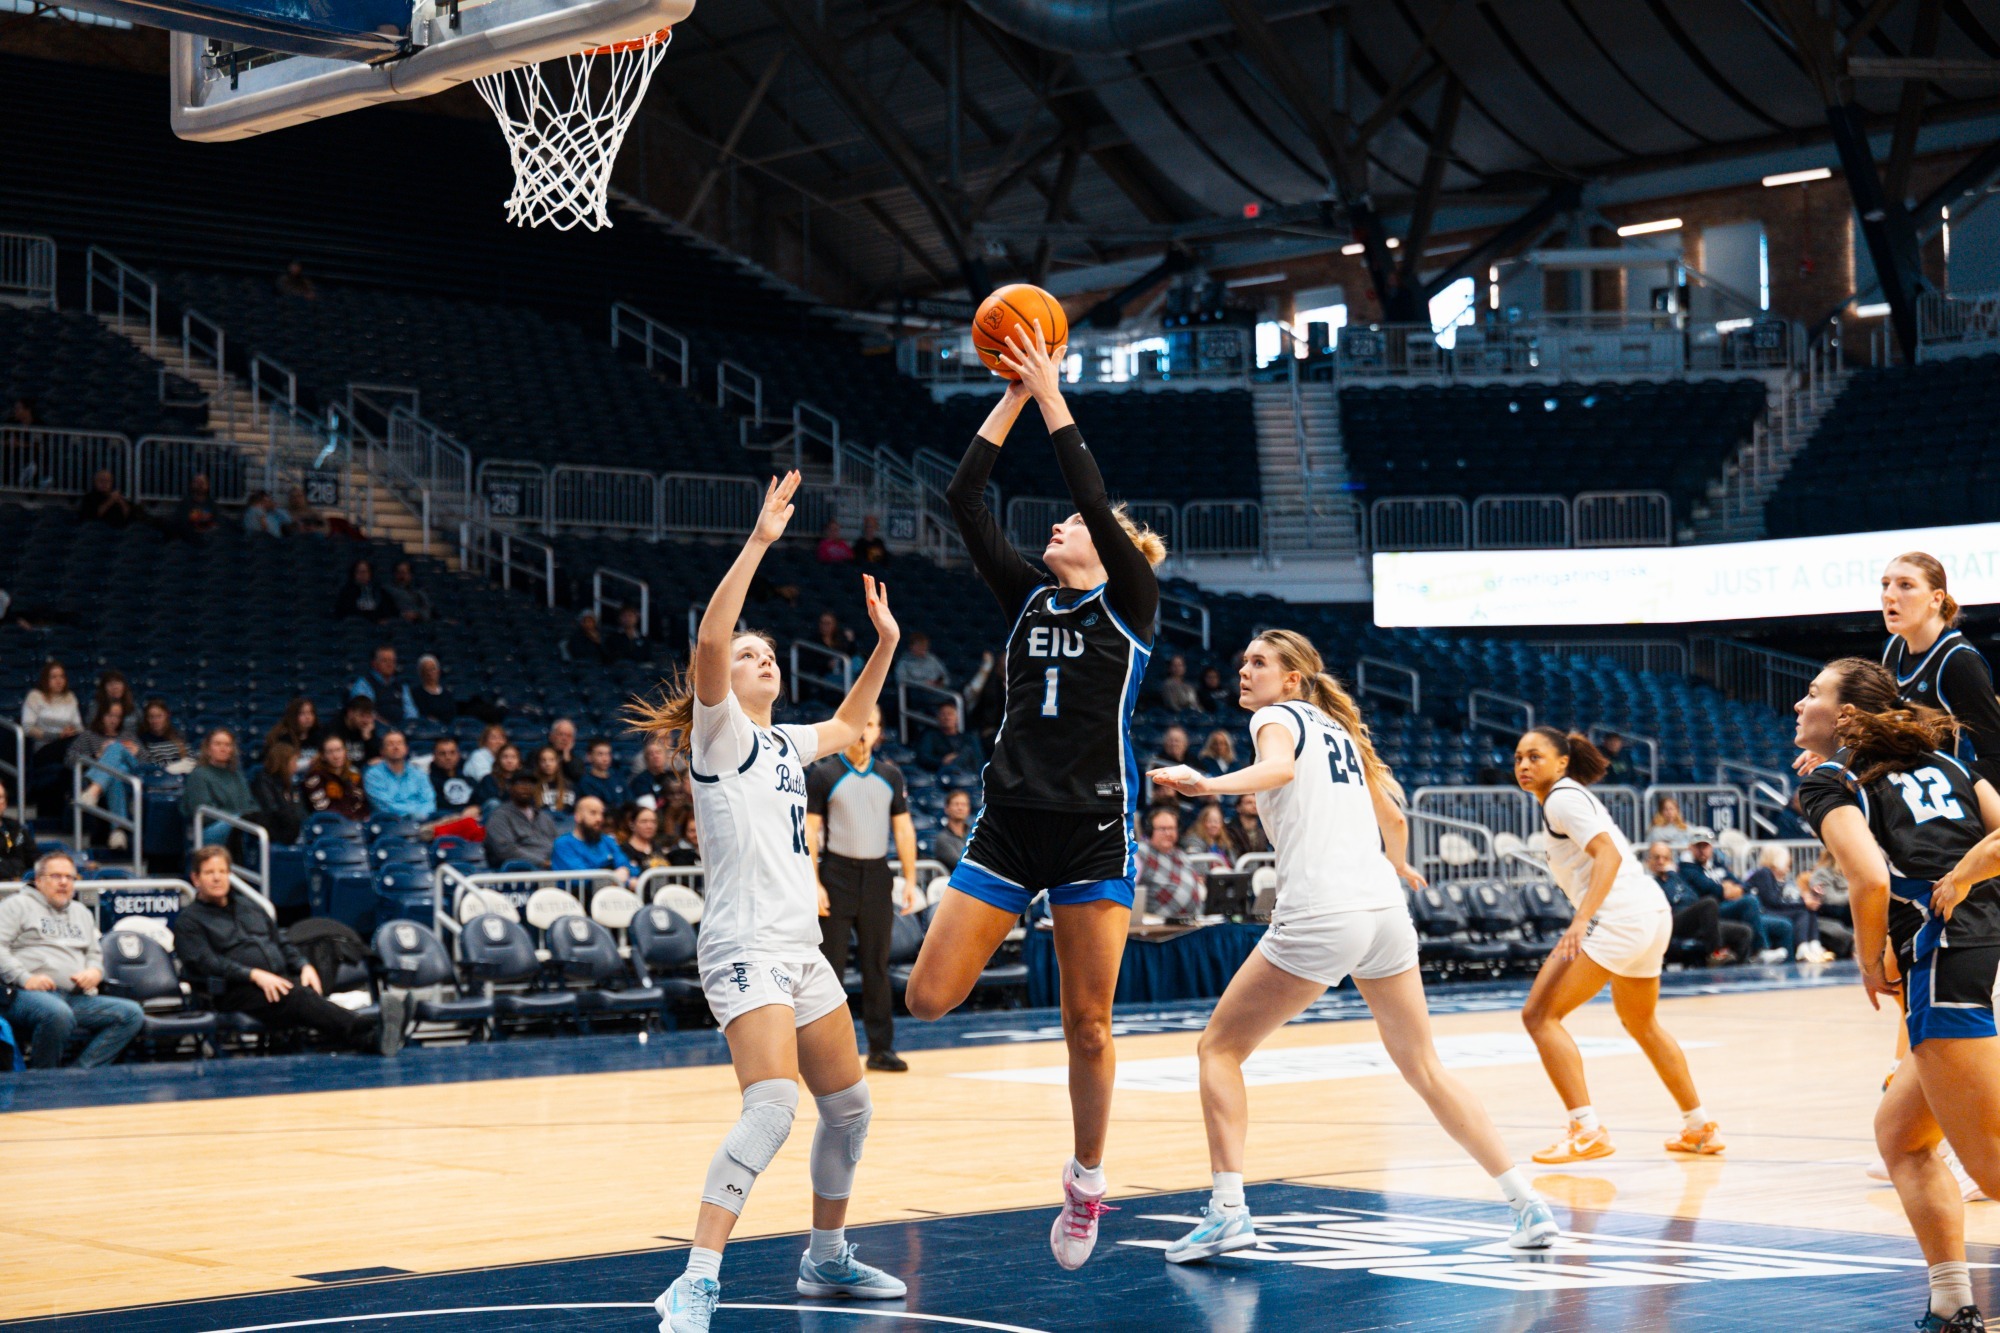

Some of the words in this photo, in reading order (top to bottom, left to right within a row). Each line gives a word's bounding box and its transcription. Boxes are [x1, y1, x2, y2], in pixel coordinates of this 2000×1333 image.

[1483, 573, 1505, 593] of
[1509, 567, 1611, 589] mitigating
[1615, 562, 1648, 578] risk
[1705, 565, 1782, 597] JUST
[1791, 563, 1812, 592] A
[1821, 558, 1886, 590] GRE
[1027, 626, 1085, 658] EIU
[1041, 667, 1059, 718] 1
[1323, 732, 1364, 786] 24
[1886, 766, 1966, 825] 22
[114, 895, 180, 914] SECTION
